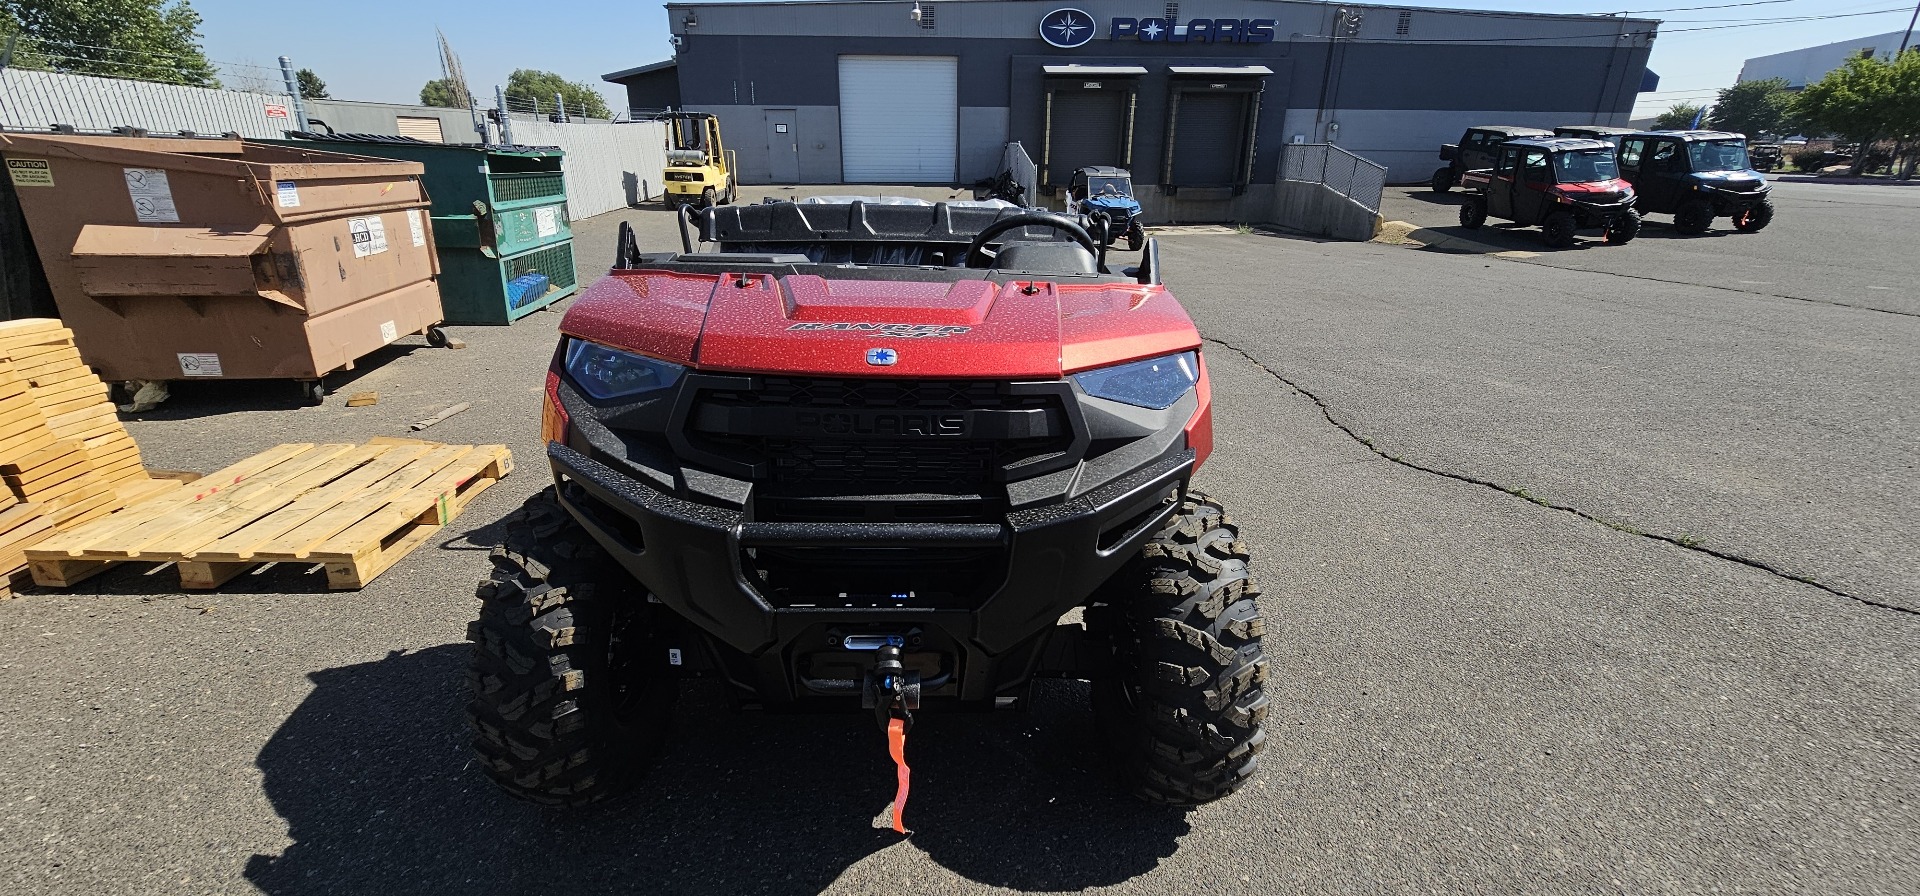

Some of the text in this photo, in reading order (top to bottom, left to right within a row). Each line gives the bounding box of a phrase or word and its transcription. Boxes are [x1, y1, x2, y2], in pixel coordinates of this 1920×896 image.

[1111, 17, 1275, 42] POLARIS
[354, 232, 369, 243] HCD
[786, 322, 972, 334] RANGER
[795, 412, 966, 436] POLARIS
